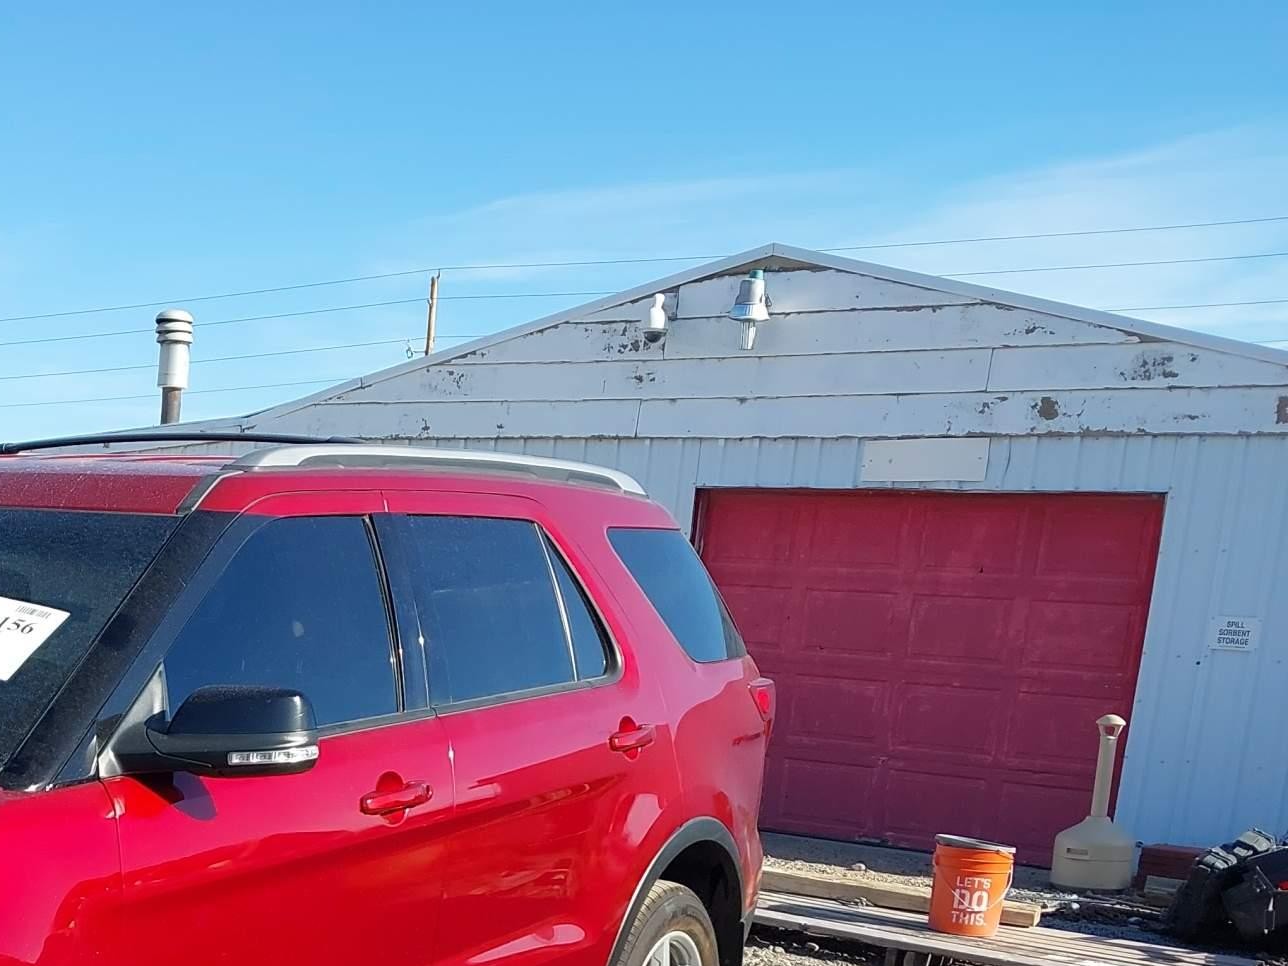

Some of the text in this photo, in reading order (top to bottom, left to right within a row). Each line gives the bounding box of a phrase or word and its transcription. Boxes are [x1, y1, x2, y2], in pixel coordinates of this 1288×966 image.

[1227, 621, 1245, 629] SPILL
[1219, 629, 1251, 637] SORBENT
[1217, 637, 1249, 646] STORAGE
[956, 875, 992, 888] LET'S
[952, 888, 990, 911] DO
